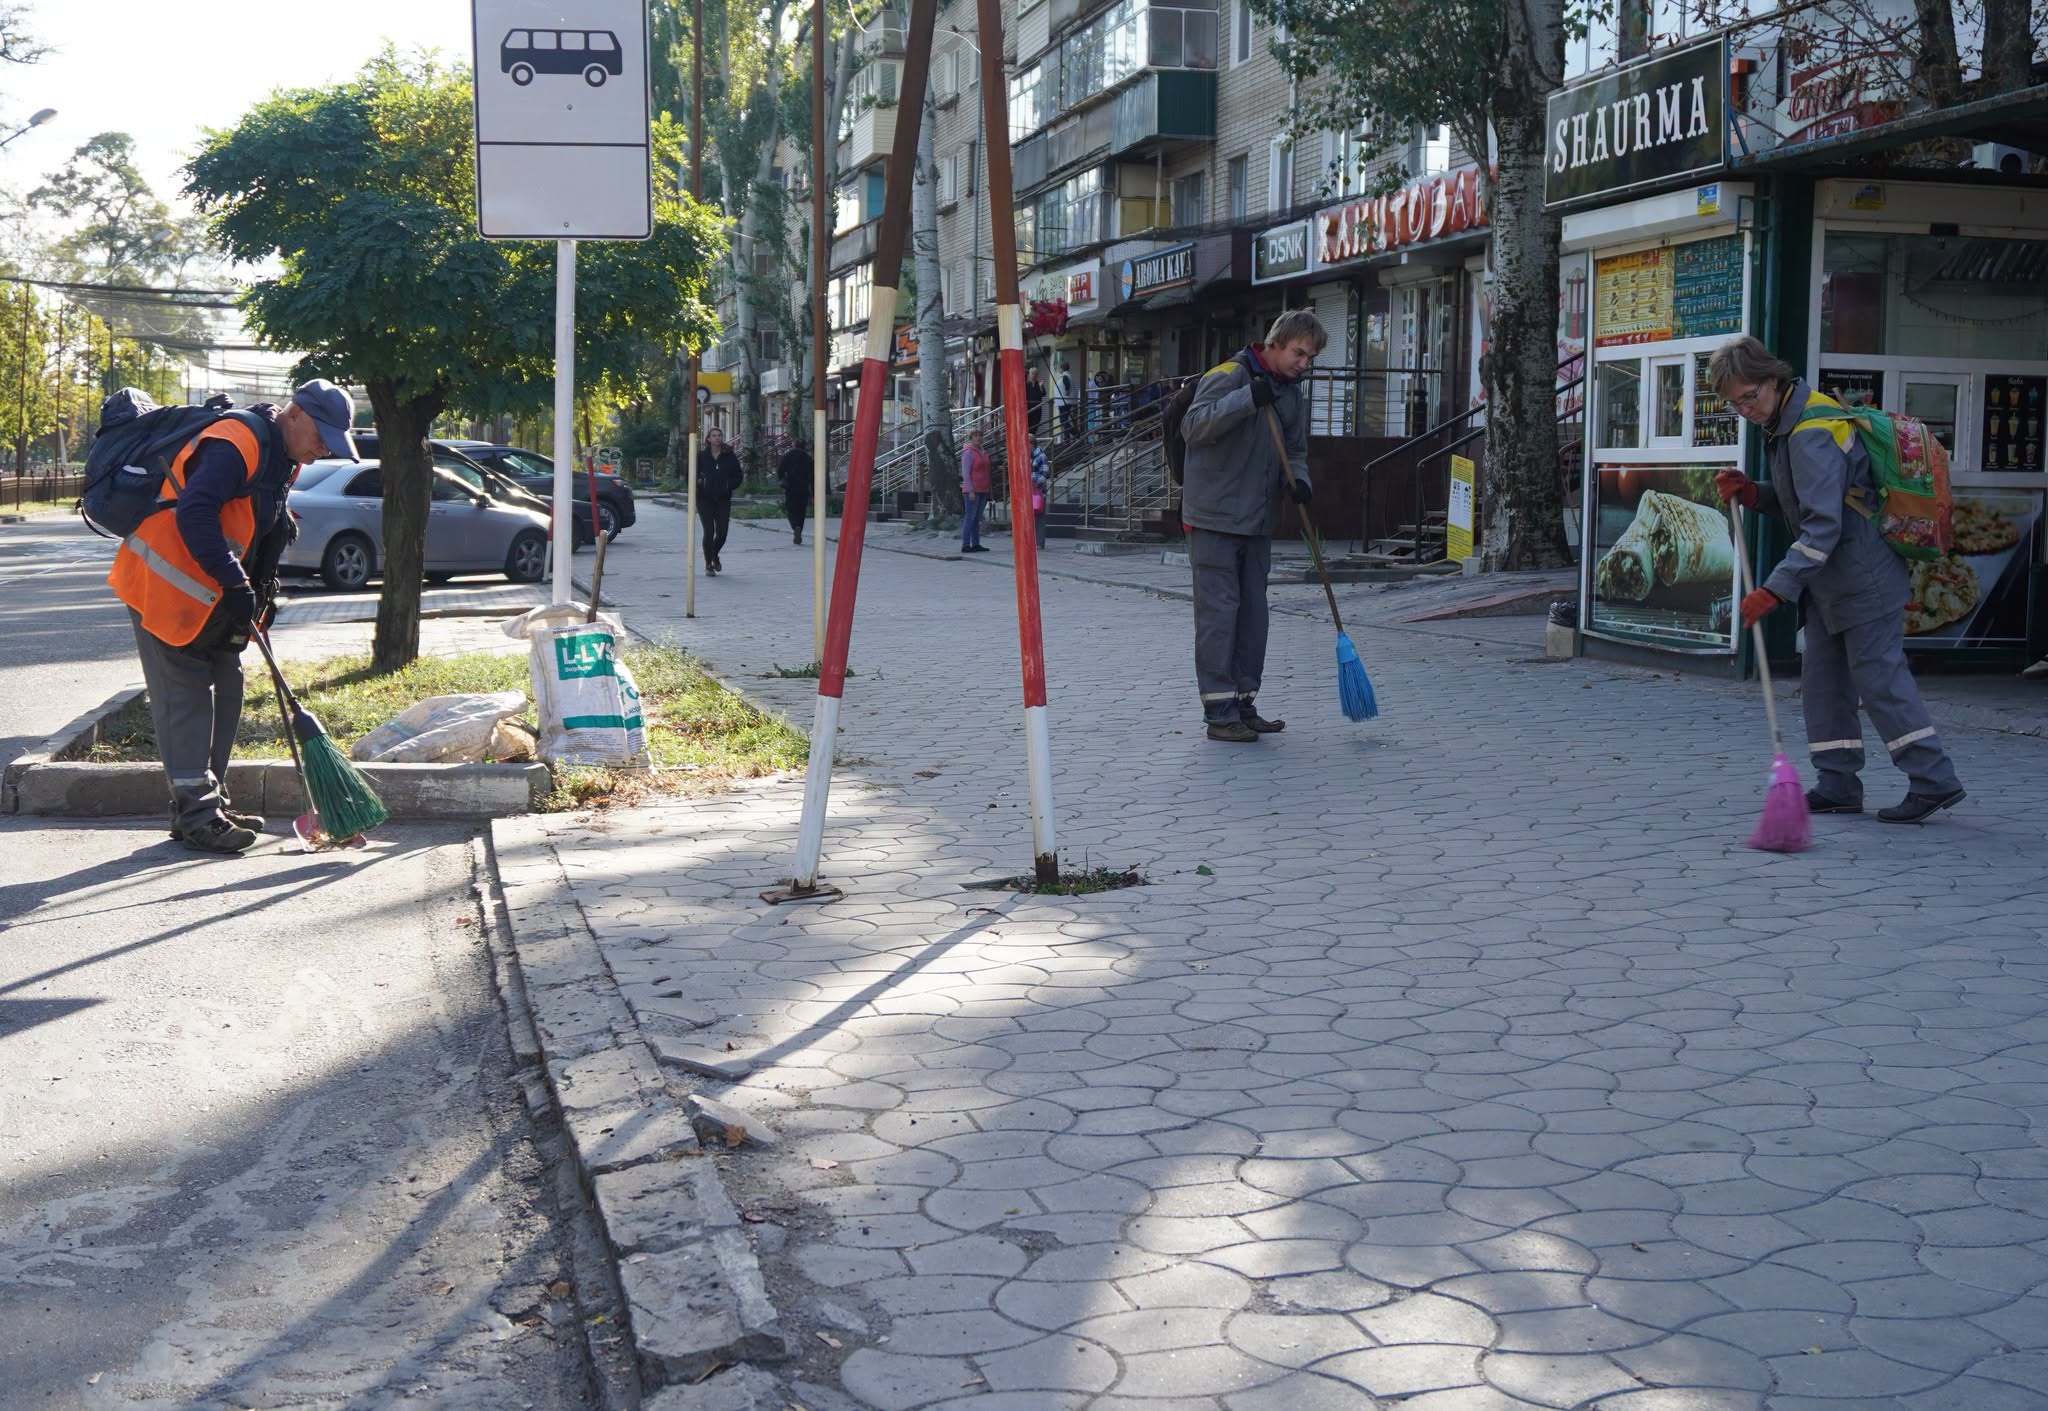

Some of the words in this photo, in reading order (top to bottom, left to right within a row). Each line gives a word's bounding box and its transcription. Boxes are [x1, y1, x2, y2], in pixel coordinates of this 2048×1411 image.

[1553, 75, 1709, 173] SHAURMA
[1268, 231, 1304, 265] DSNK
[1135, 257, 1166, 289] AROMA
[1166, 250, 1192, 281] KAVA
